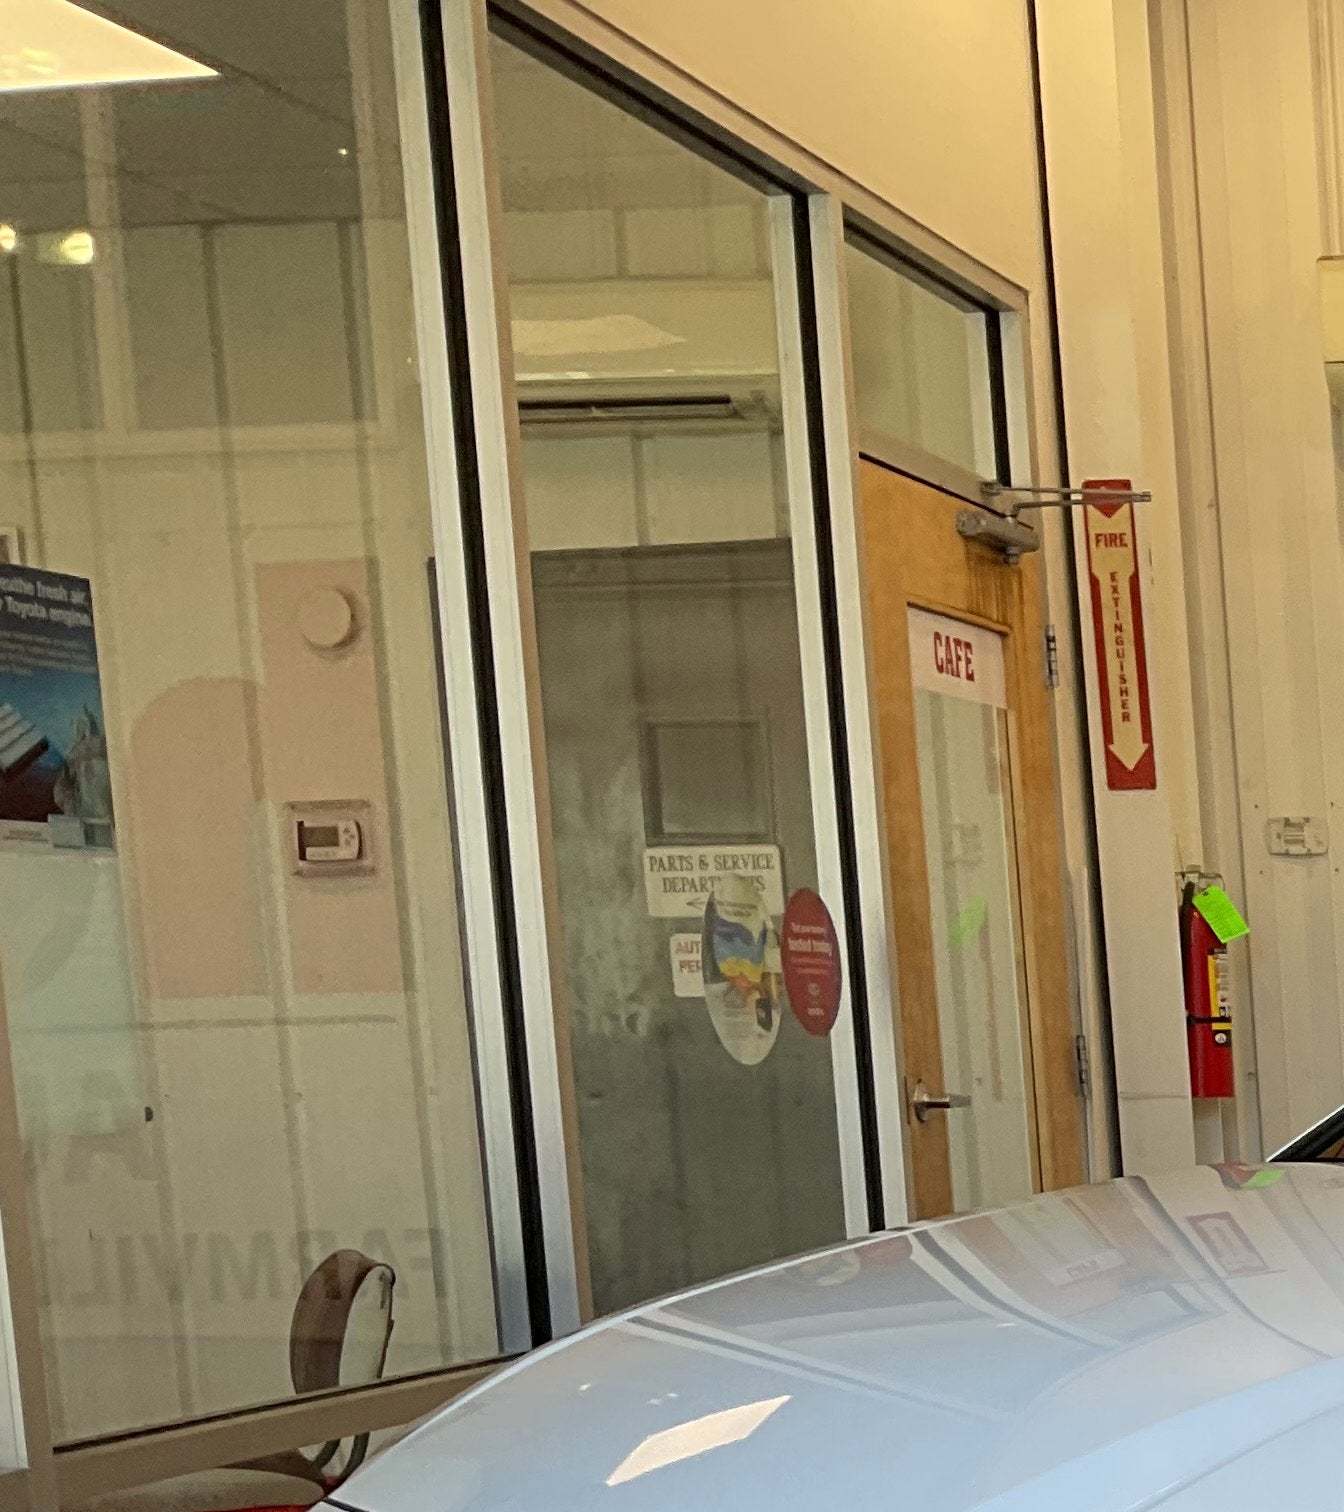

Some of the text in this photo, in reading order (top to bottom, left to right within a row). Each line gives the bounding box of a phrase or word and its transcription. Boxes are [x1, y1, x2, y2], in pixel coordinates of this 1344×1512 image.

[1094, 532, 1128, 549] FIRE
[933, 631, 975, 682] CAFE
[1109, 570, 1131, 723] EXTINGUISHER
[648, 853, 774, 872] PARTS & SERVICE
